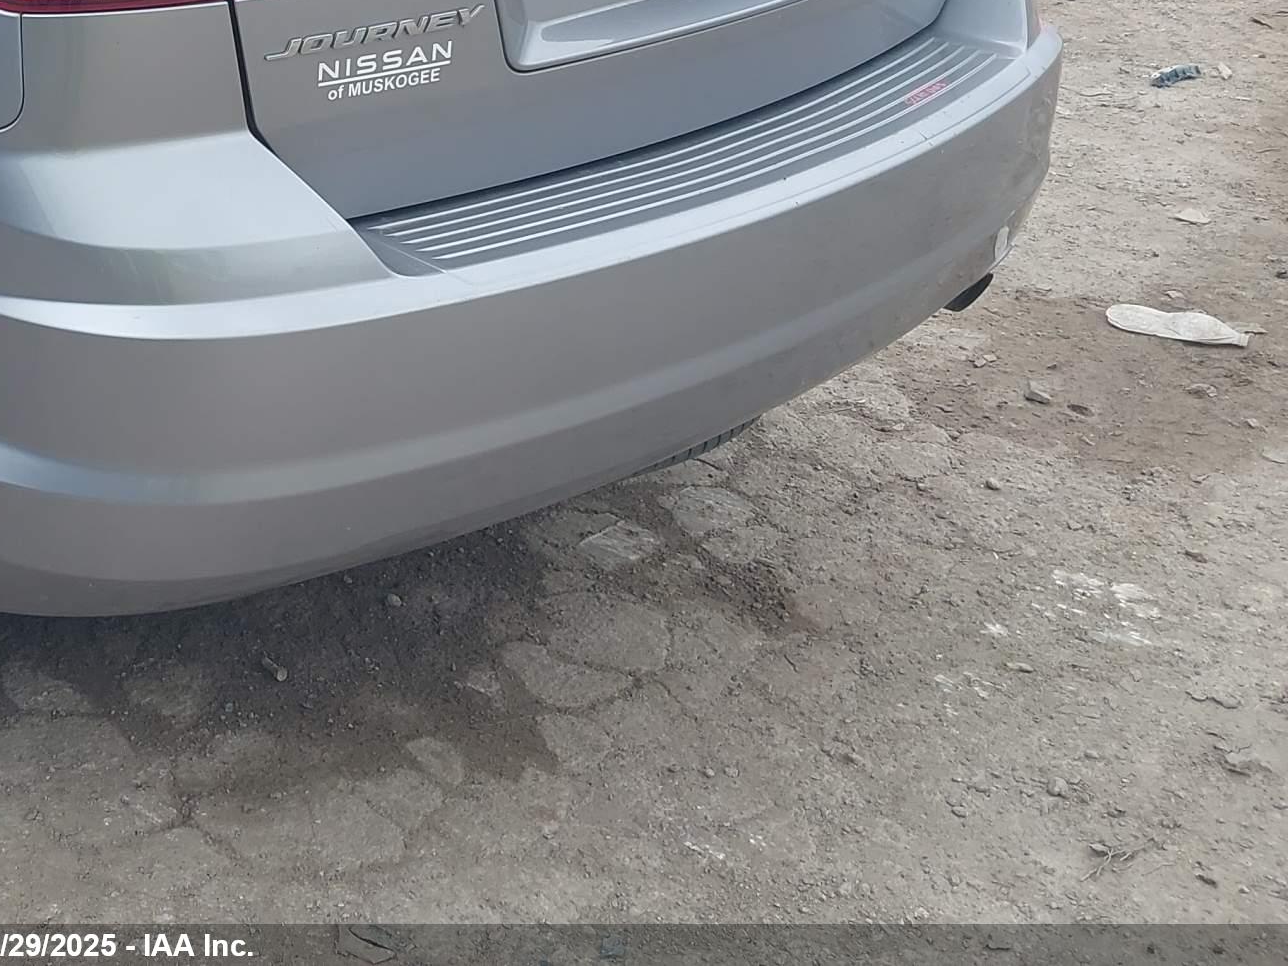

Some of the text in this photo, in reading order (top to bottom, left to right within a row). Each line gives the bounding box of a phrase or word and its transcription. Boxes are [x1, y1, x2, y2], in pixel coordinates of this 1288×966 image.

[264, 4, 486, 61] JOURNEY
[318, 40, 453, 82] NISSAN
[327, 67, 441, 101] of MUSKOGEE
